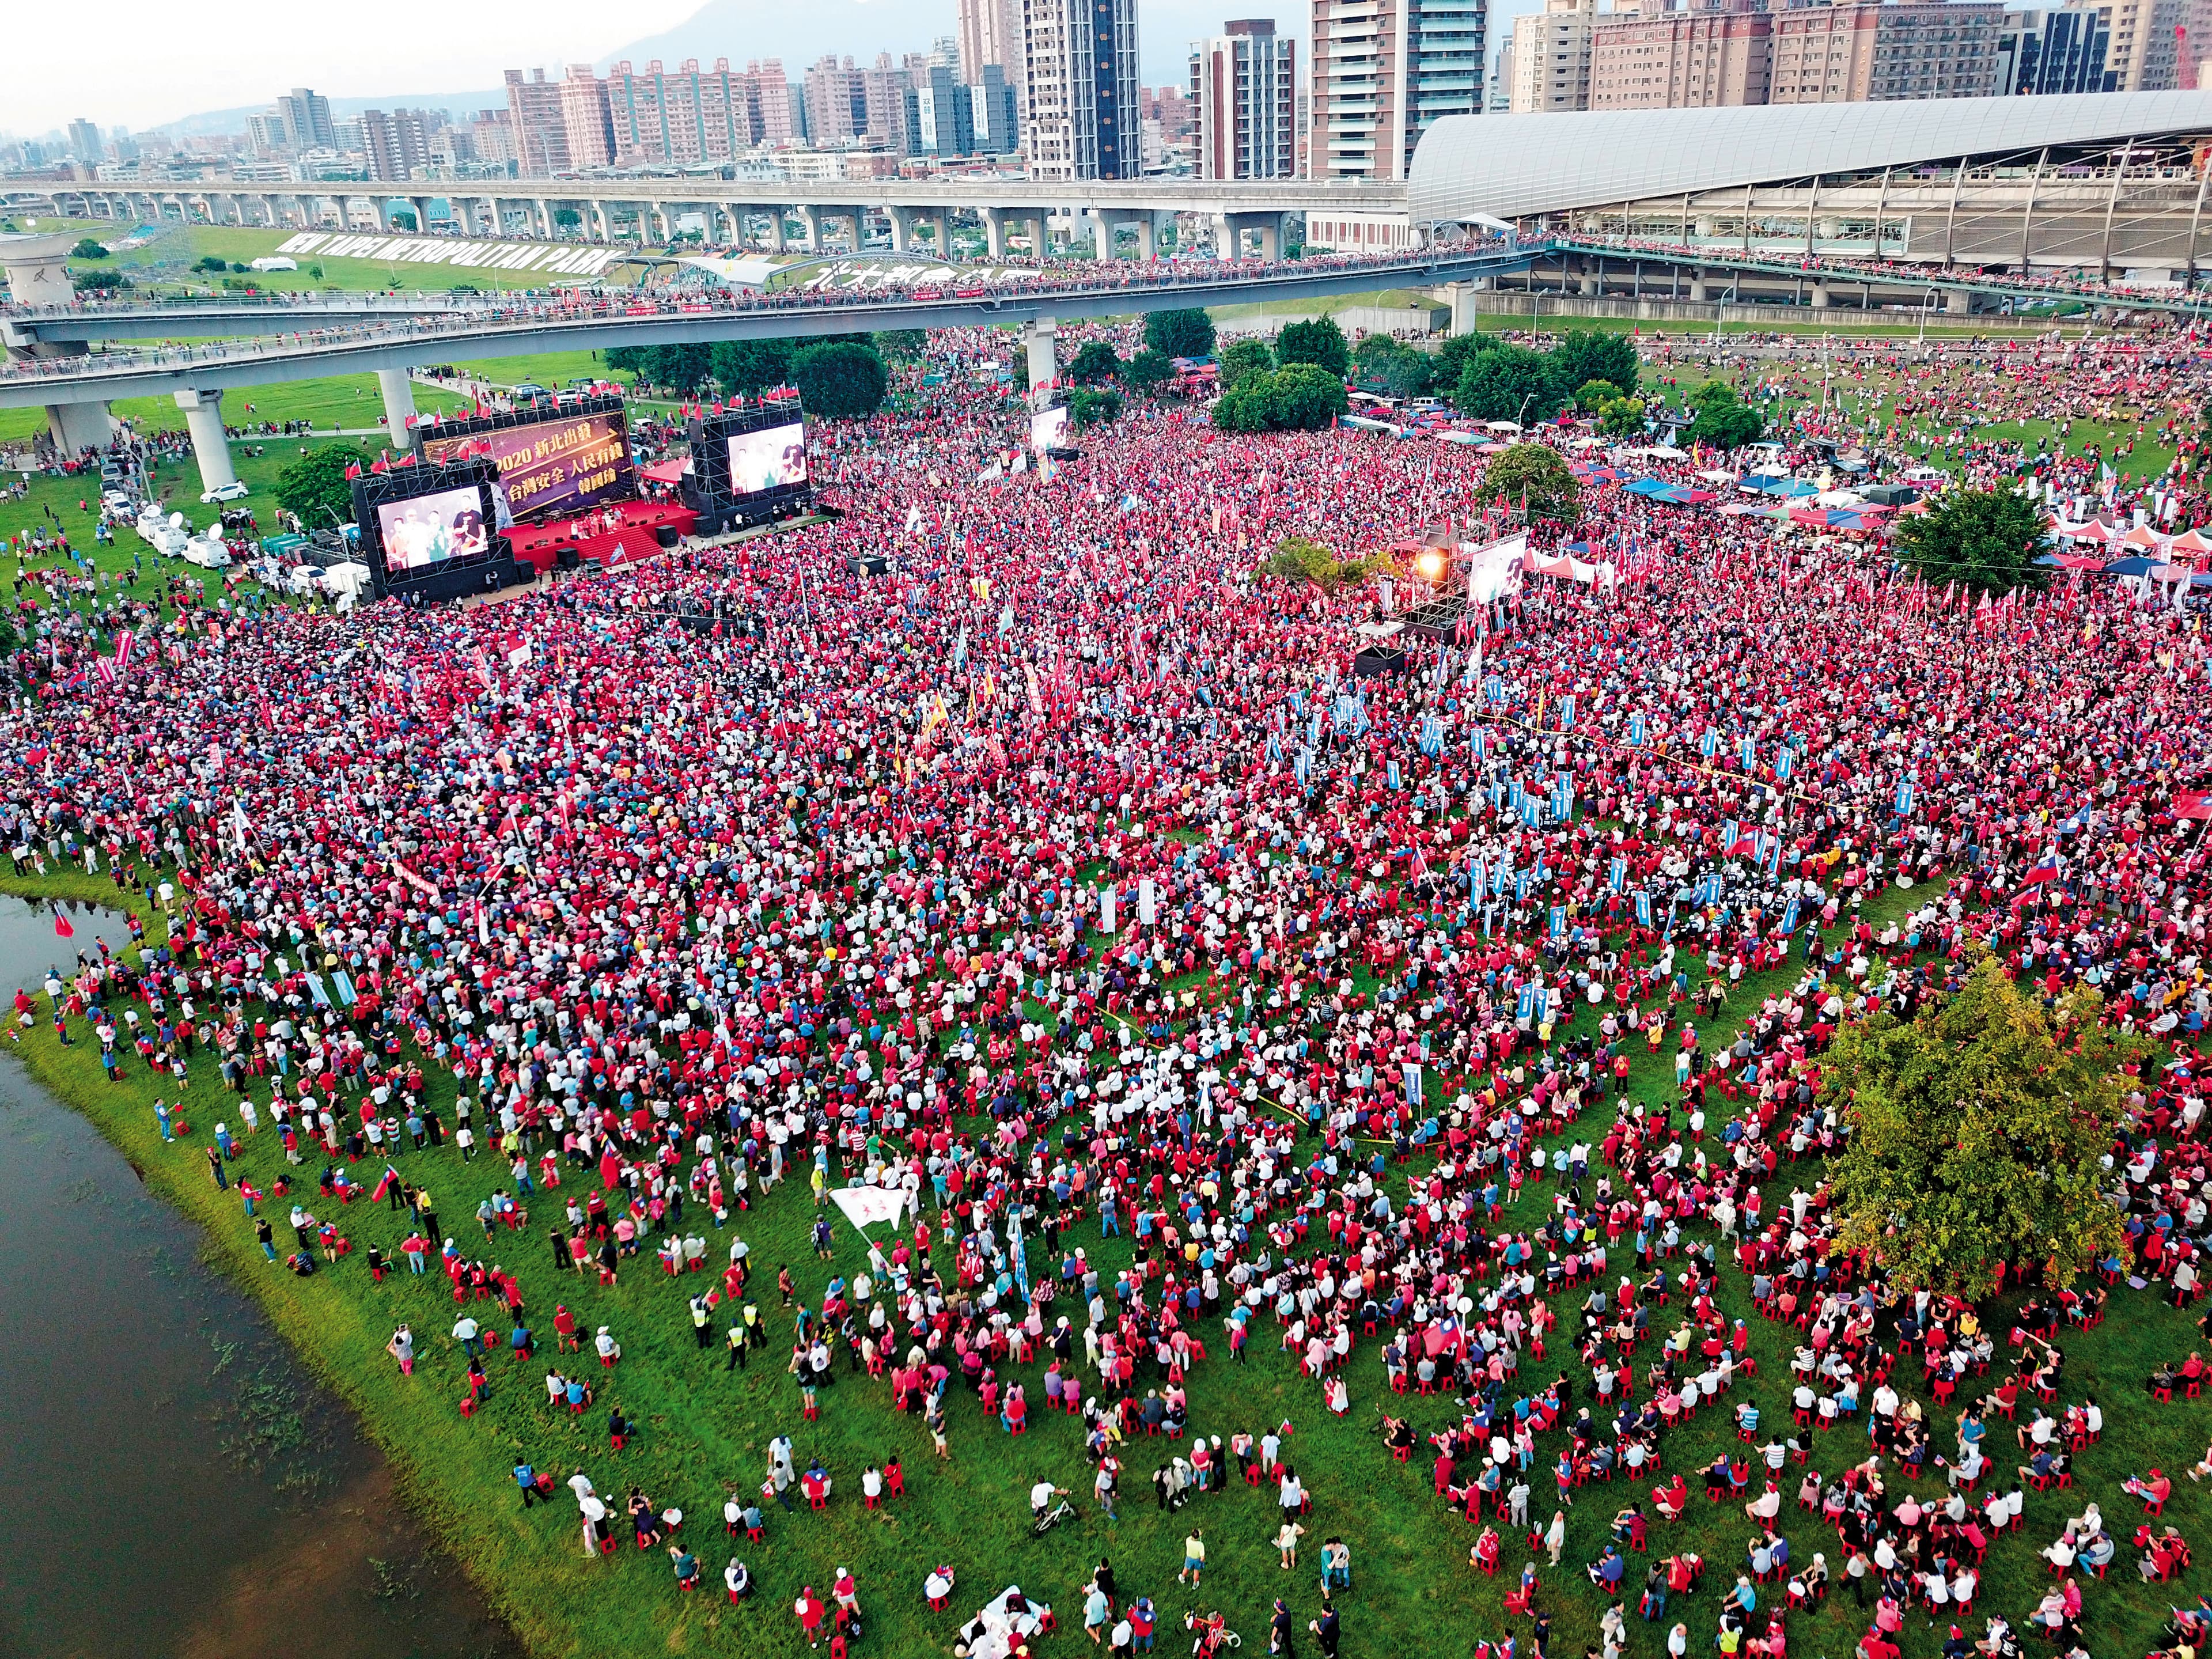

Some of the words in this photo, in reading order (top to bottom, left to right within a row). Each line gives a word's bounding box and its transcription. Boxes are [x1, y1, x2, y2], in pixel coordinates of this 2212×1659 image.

[274, 233, 332, 253] NEW
[315, 235, 391, 258] TAIPEI
[370, 238, 551, 270] METROPOLITAN
[530, 247, 627, 275] PARK
[497, 448, 532, 474] 2020
[534, 422, 592, 458] 新北出發
[508, 467, 566, 502] 台灣安全
[571, 442, 624, 478] 人民有錢
[578, 468, 616, 495] 韓國瑜
